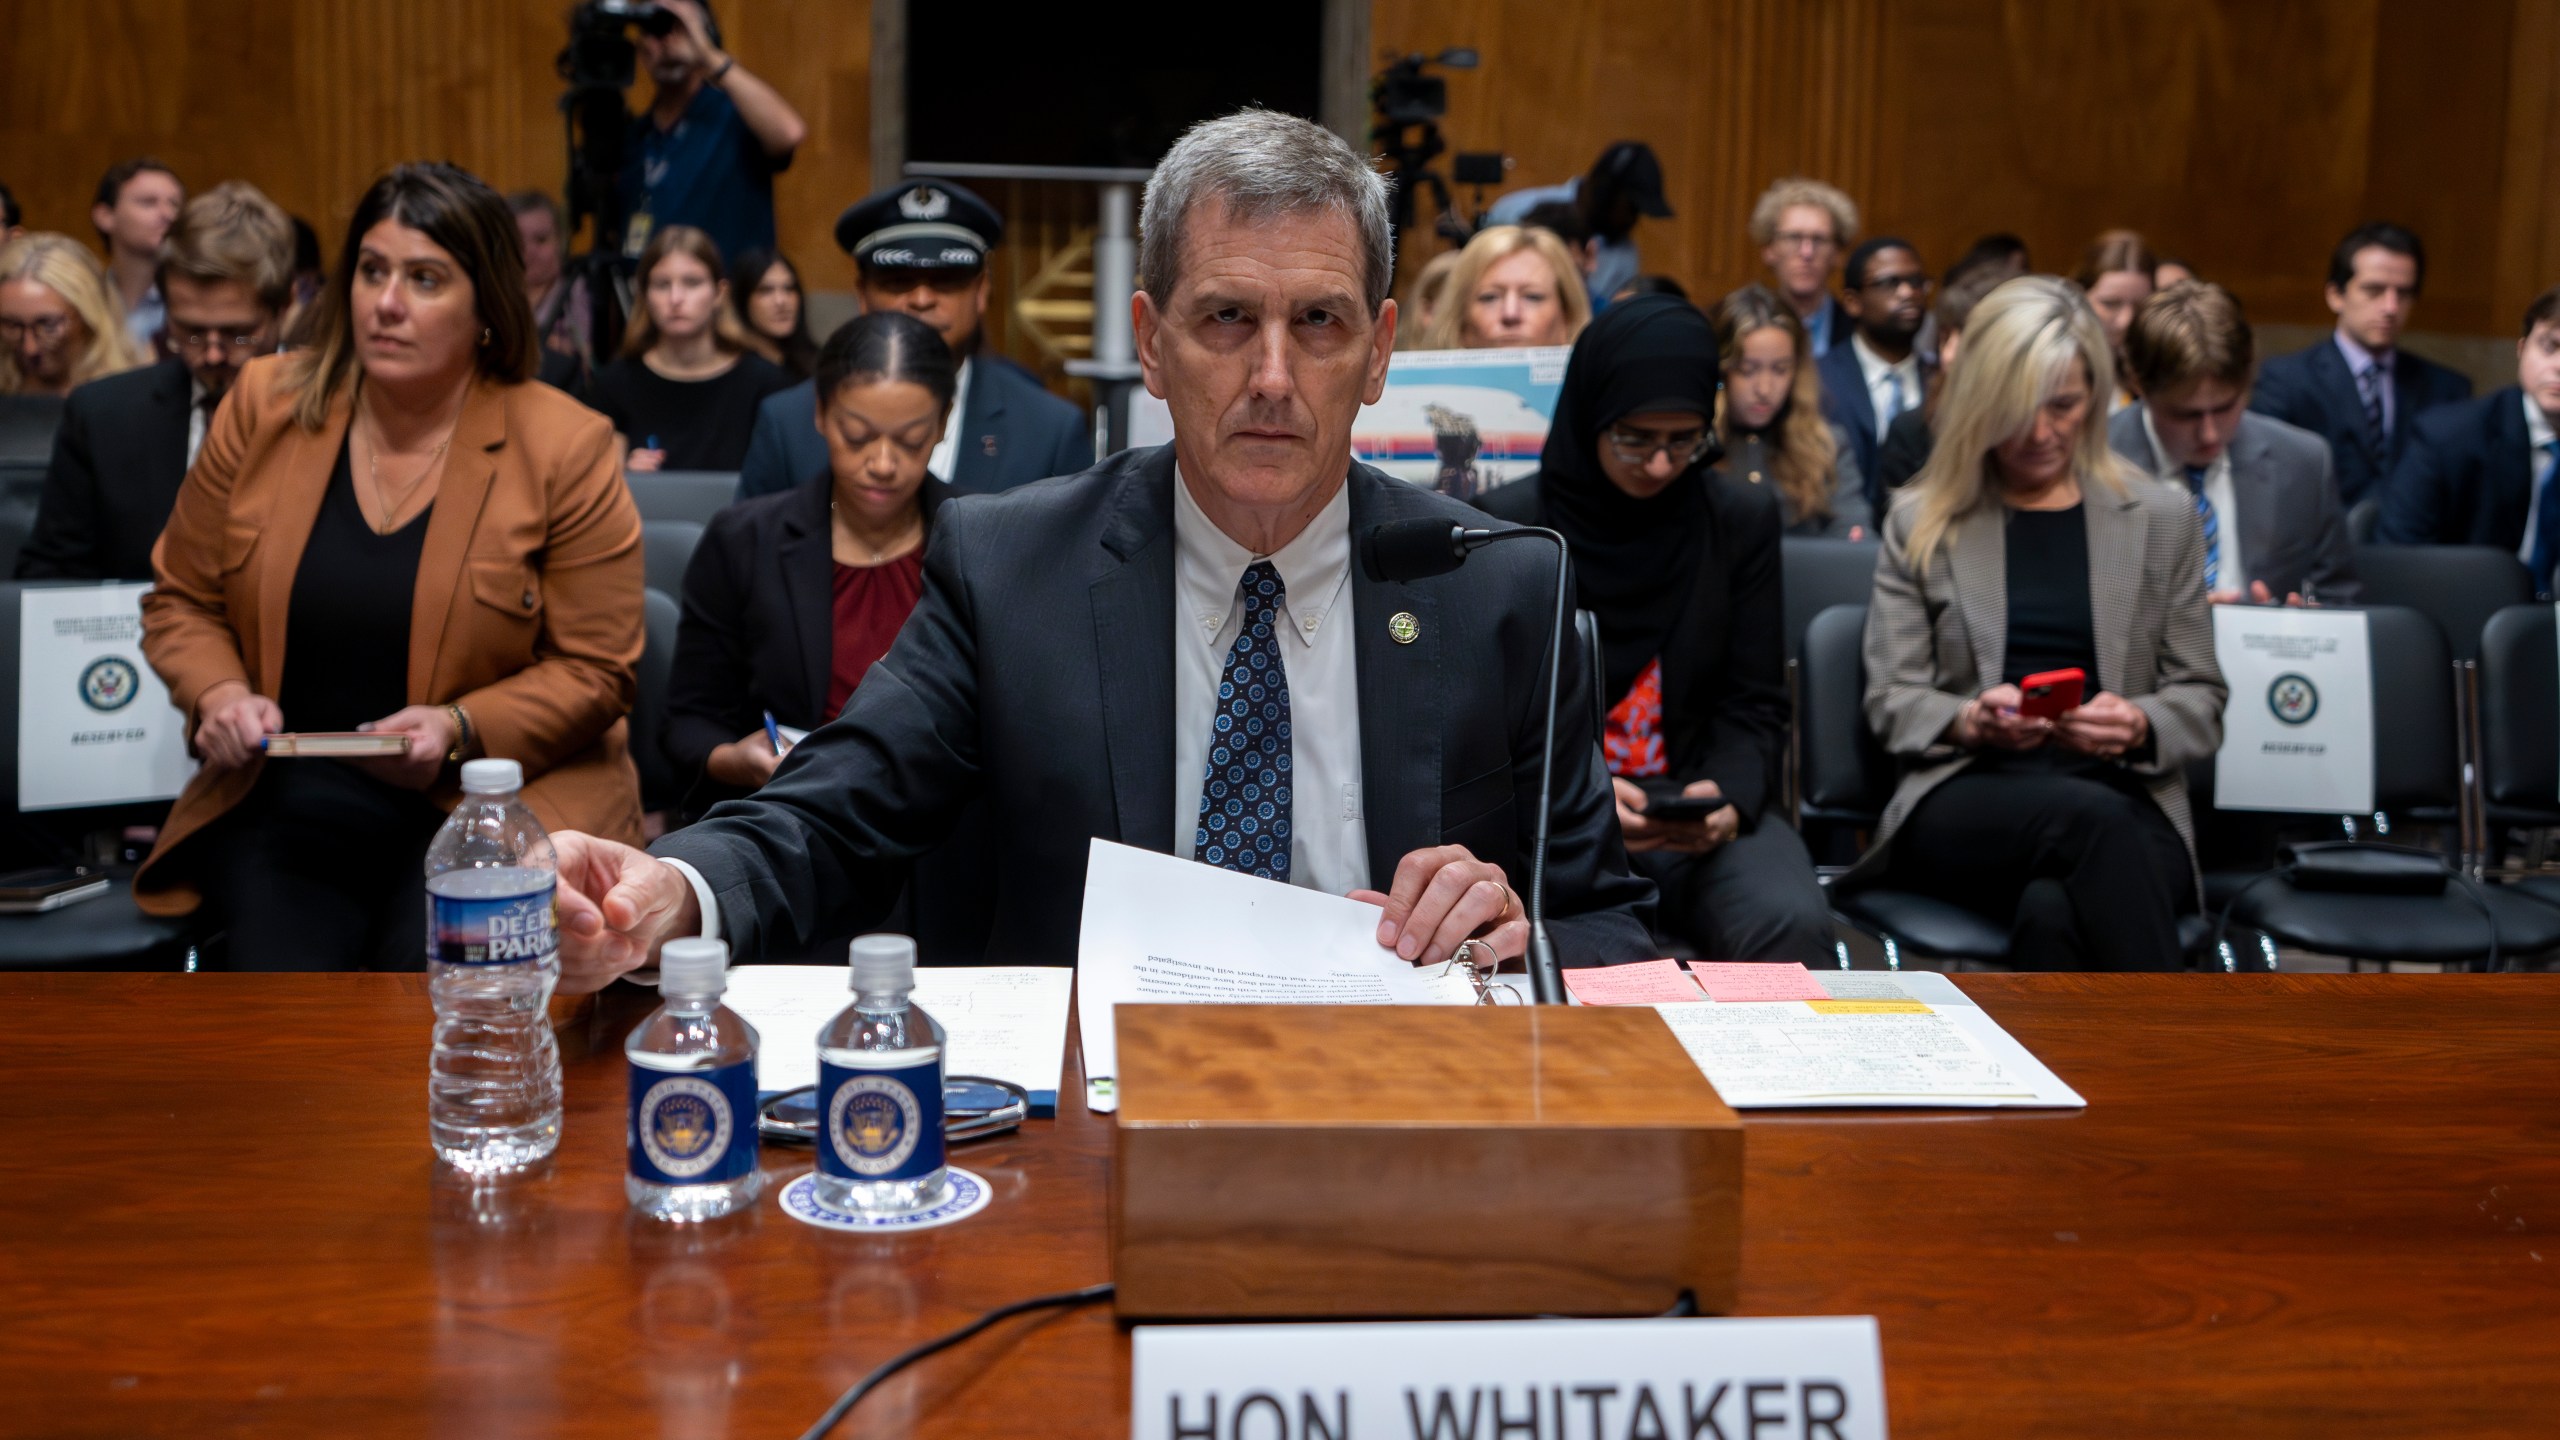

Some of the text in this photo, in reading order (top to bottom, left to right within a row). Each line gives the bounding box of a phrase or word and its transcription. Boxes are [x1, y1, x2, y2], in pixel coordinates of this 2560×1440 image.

[71, 730, 146, 746] RESERVED
[2262, 742, 2326, 755] RESERVED
[488, 907, 552, 937] DEER
[488, 929, 552, 960] PARK
[1147, 955, 1201, 970] investigated
[1137, 976, 1181, 987] concerns,
[1160, 970, 1211, 982] confidence
[876, 1081, 916, 1123] STATES
[654, 1152, 714, 1172] SENATE
[843, 1150, 904, 1171] SENATE
[1404, 1379, 1850, 1440] WHITAKER
